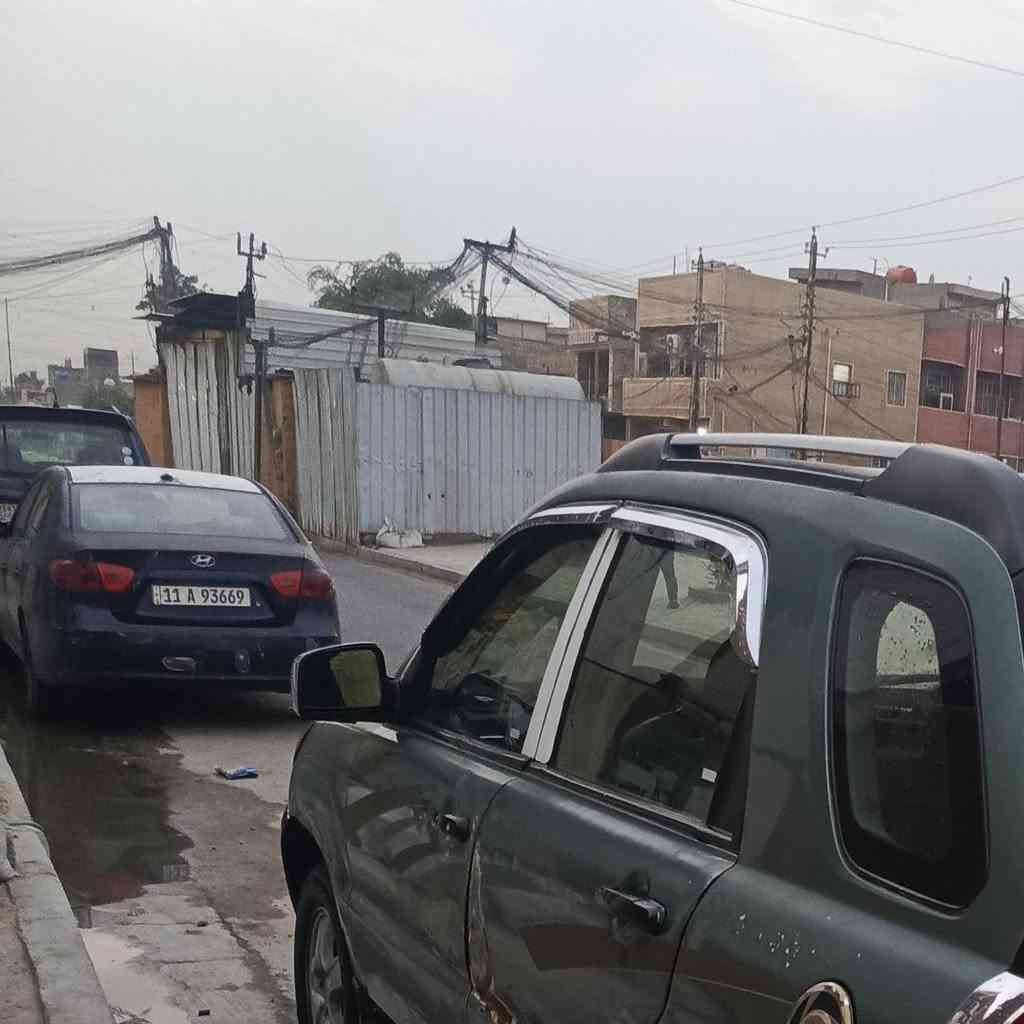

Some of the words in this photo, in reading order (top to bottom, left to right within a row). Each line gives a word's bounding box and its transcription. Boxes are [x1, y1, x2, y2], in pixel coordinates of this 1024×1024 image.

[163, 587, 181, 603] 11
[187, 588, 196, 604] A
[201, 588, 245, 605] 93669
